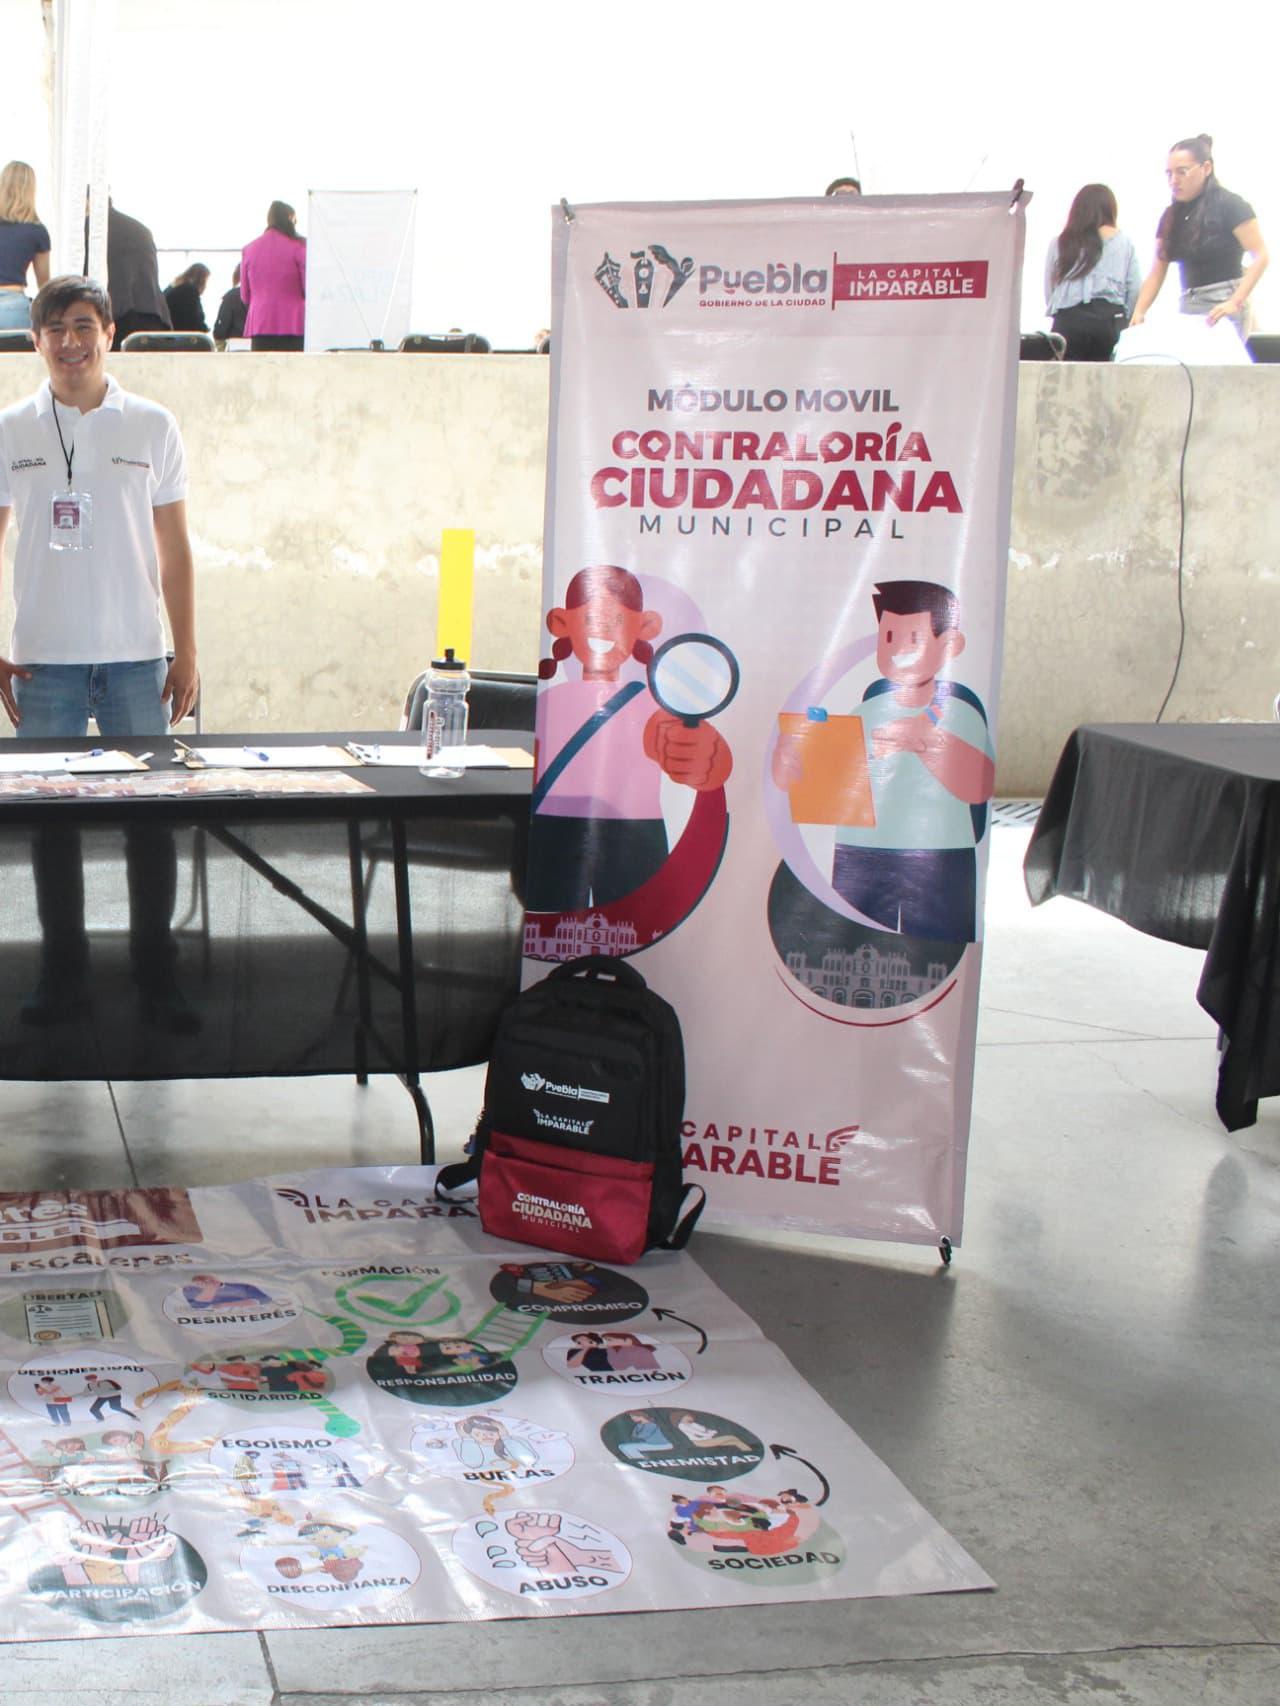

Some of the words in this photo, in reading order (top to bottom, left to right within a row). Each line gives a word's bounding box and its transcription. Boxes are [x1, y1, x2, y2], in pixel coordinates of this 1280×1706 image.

[699, 262, 828, 295] Puebla
[857, 269, 878, 279] LA
[887, 268, 963, 279] CAPITAL
[849, 278, 974, 297] IMPARABLE
[699, 299, 753, 307] GOBIERNO
[754, 299, 768, 307] DE
[770, 299, 784, 307] LA
[786, 298, 826, 307] CIUDAD
[648, 382, 787, 412] MÓDULO
[795, 389, 899, 412] MOVIL
[612, 421, 932, 464] CONTRALORÍA
[591, 466, 964, 513] CIUDADANA
[639, 514, 904, 539] MUNICIPAL
[537, 1118, 590, 1135] IMPARABLE
[680, 1120, 821, 1150] CAPITAL
[682, 1142, 841, 1186] ARABLE
[315, 1194, 354, 1208] LA
[516, 1192, 586, 1216] CONTRALORÍA
[304, 1206, 479, 1224] IMPARA
[512, 1201, 593, 1229] CIUDADANA
[517, 1301, 643, 1313] COMPROMISO
[177, 1309, 297, 1324] DESINTERÉS
[376, 1372, 516, 1388] RESPONSABILIDAD
[574, 1369, 686, 1385] TRAICIÓN
[207, 1391, 323, 1401] SOLIDARIDAD
[638, 1454, 761, 1469] ENEMISTAD
[708, 1551, 841, 1571] SOCIEDAD
[38, 1578, 201, 1599] ARTICIPACIÓN
[267, 1576, 411, 1594] DESCONFIANZA
[519, 1576, 609, 1594] ABUSO
